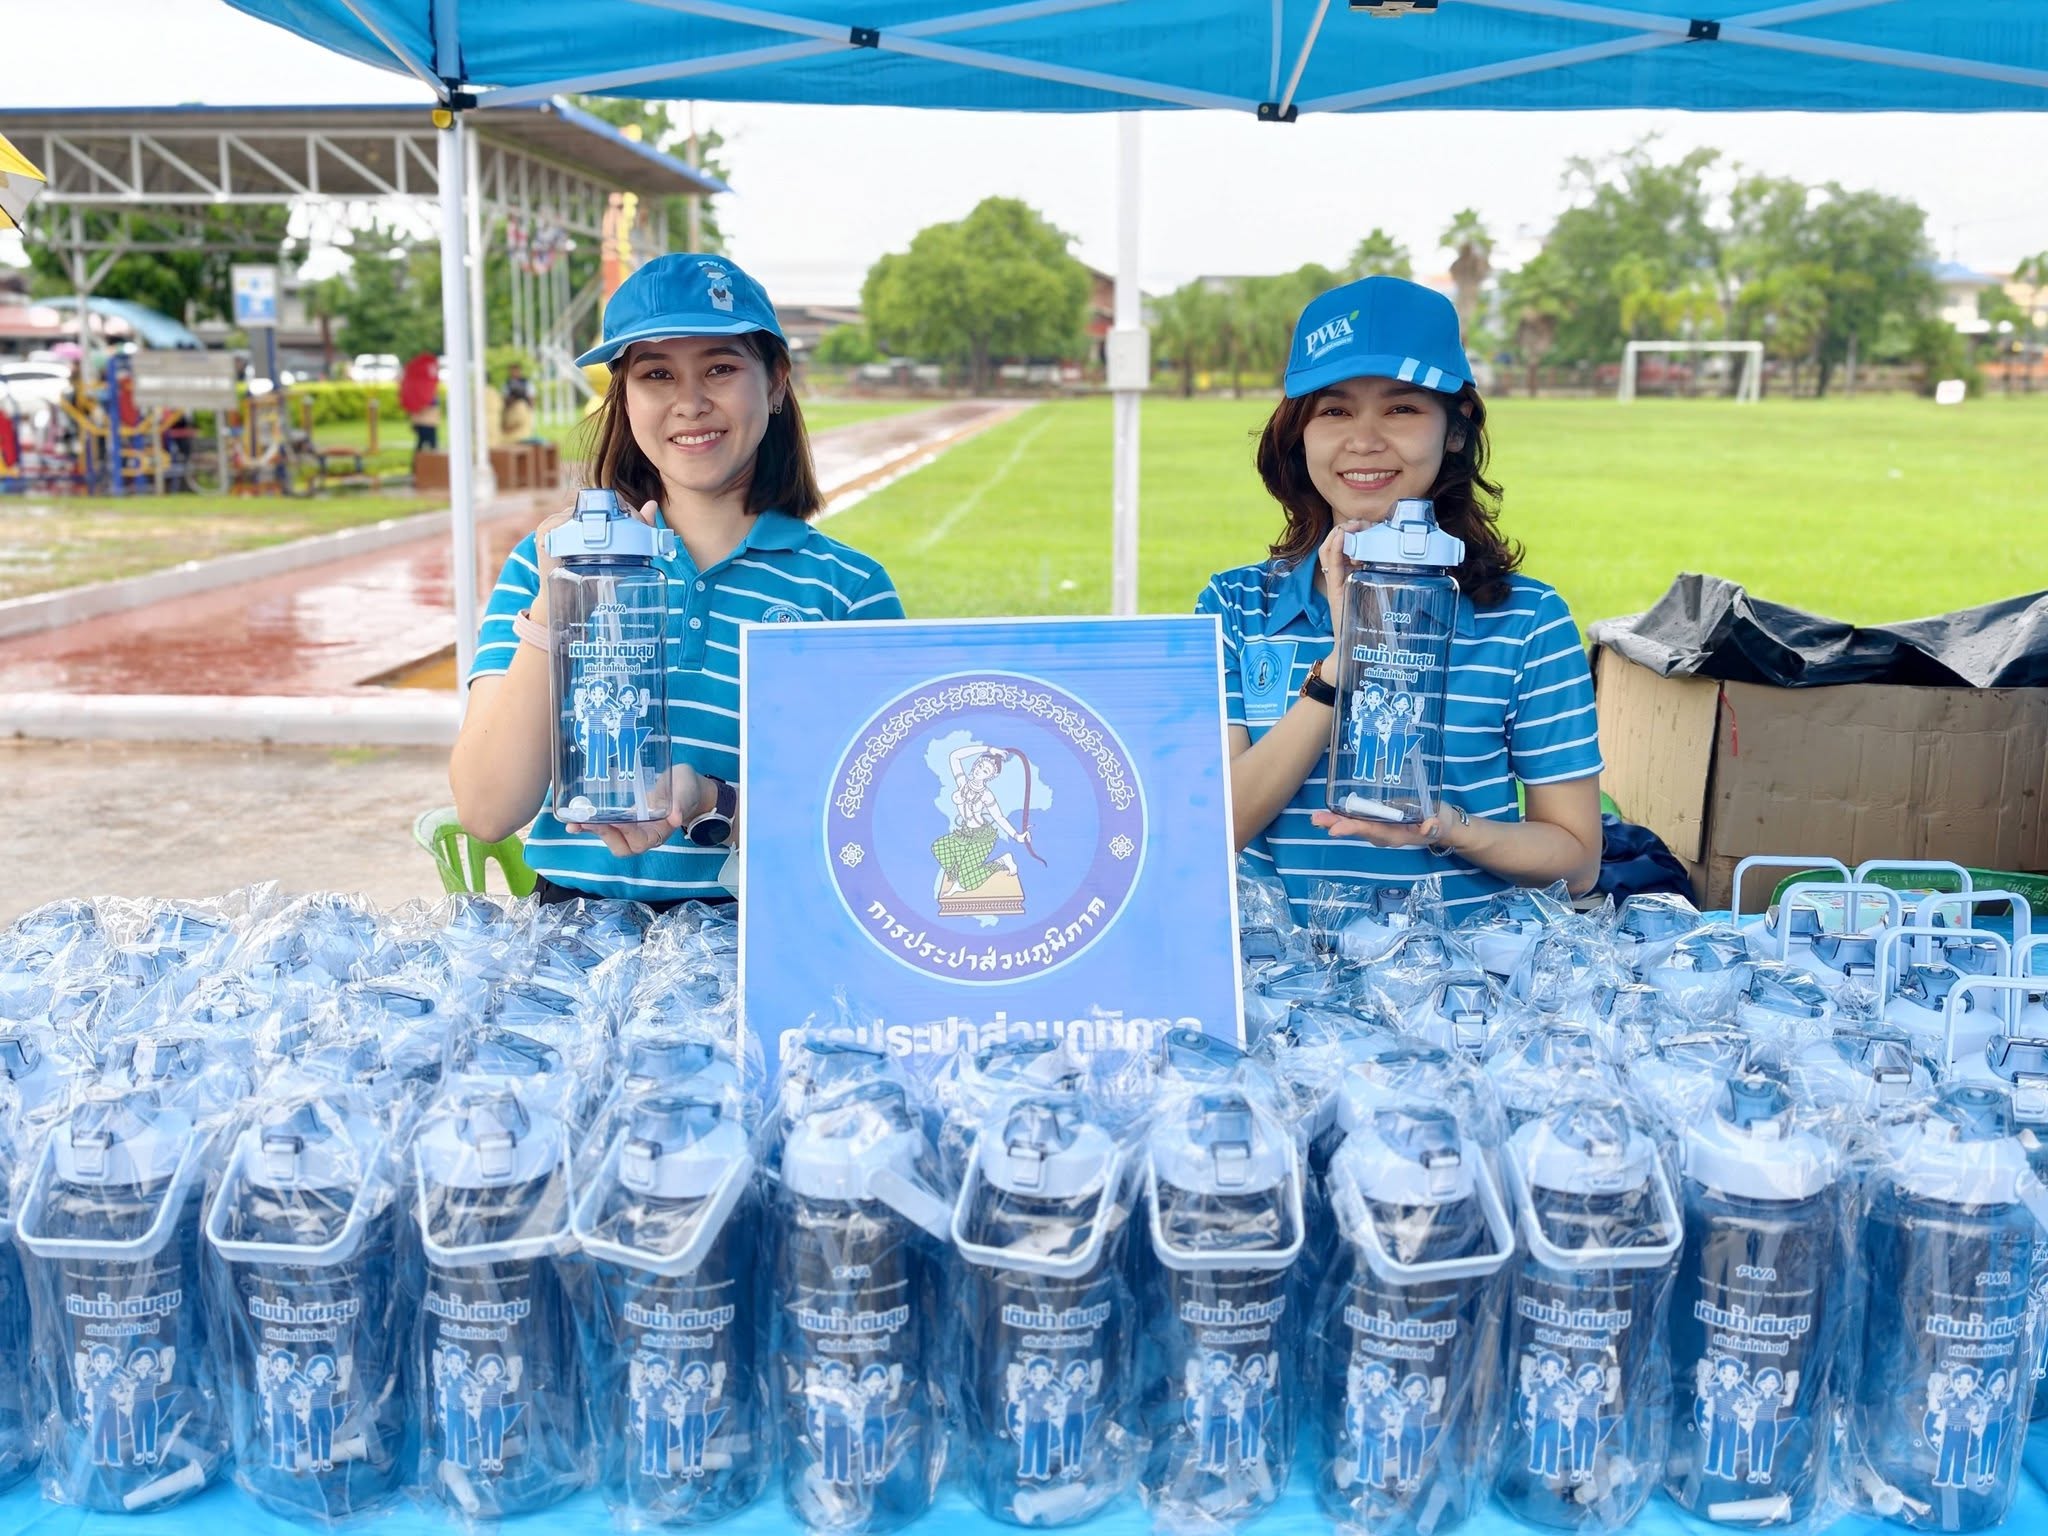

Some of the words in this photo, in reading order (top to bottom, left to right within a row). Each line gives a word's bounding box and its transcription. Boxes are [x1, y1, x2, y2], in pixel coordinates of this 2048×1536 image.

[1305, 317, 1354, 356] PWA
[597, 603, 627, 614] PWA
[1383, 612, 1411, 624] PWA
[568, 637, 611, 658] เติมน้ำ
[611, 641, 655, 662] เติมสุข
[1352, 643, 1391, 665] เติมน้ำ
[1391, 649, 1436, 671] เติมสุข
[866, 896, 1106, 972] การประปาส่วนภูมิภาค
[1735, 1264, 1777, 1281] PWA
[1974, 1271, 2011, 1286] PWA
[1694, 1299, 1751, 1333] เติมน้ำ
[1751, 1314, 1811, 1340] เติมสุข
